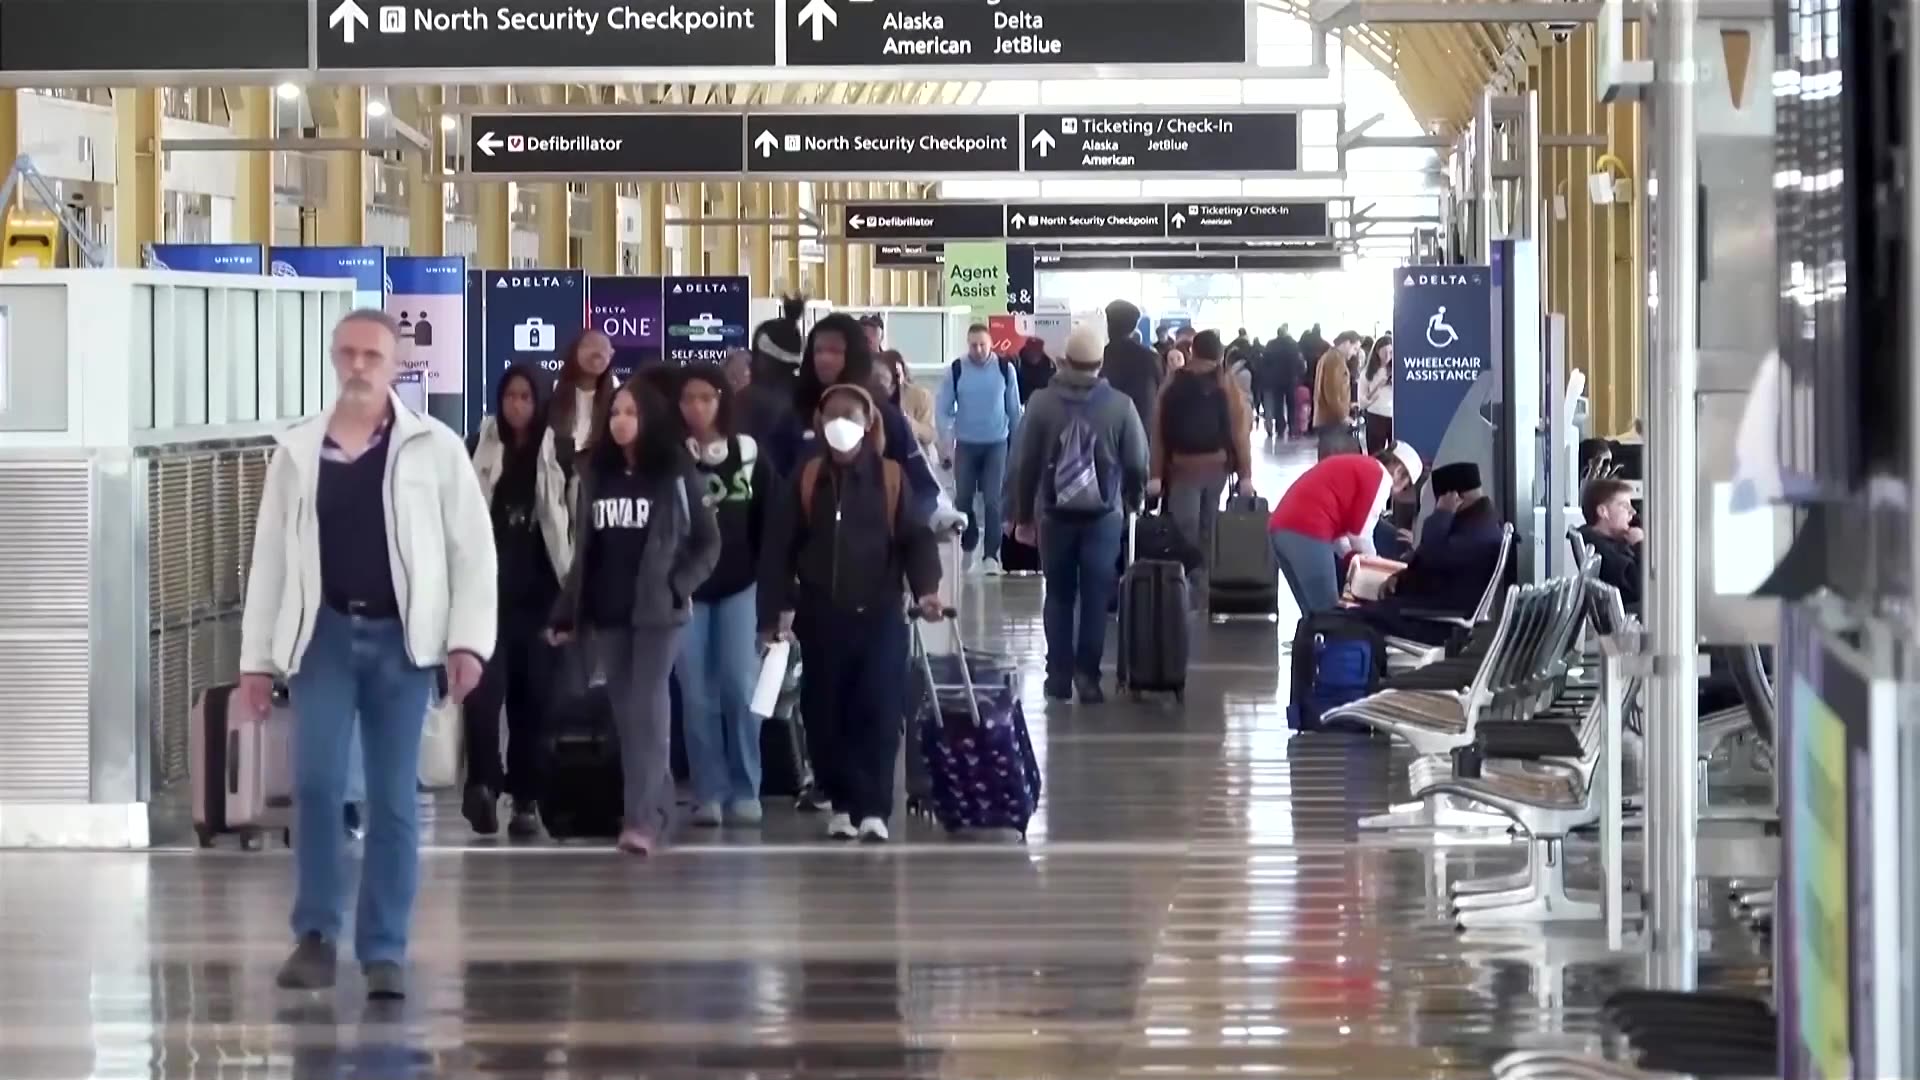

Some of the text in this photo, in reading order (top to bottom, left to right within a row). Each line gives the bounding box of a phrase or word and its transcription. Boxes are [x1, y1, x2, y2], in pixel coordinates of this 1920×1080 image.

[414, 4, 755, 36] North Security Checkpoint
[882, 11, 944, 30] Alaska
[994, 10, 1043, 29] Delta
[882, 35, 972, 55] American
[993, 34, 1062, 54] JetBlue
[1081, 117, 1233, 137] Ticketing / Check-In
[527, 135, 623, 151] Defibrillator
[804, 134, 1007, 154] North Security Checkpoint
[1081, 139, 1119, 151] Alaska
[1147, 139, 1189, 151] JetBlue
[1081, 154, 1135, 166] American
[1201, 206, 1243, 217] Ticketing
[1250, 206, 1289, 215] Check-In
[878, 216, 934, 227] Defibrillator
[1039, 215, 1159, 228] North Security Checkpoint
[214, 256, 253, 264] UNITED
[338, 258, 375, 267] UNITED
[950, 264, 998, 282] Agent
[1419, 274, 1467, 285] DELTA
[511, 276, 560, 288] DELTA
[686, 283, 727, 293] DELTA
[951, 282, 996, 297] Assist
[1019, 289, 1032, 304] &
[595, 306, 626, 314] DELTA
[603, 317, 651, 337] ONE
[671, 350, 728, 360] SELF-SERVI
[1403, 356, 1481, 369] WHEELCHAIR
[1406, 369, 1478, 381] ASSISTANCE
